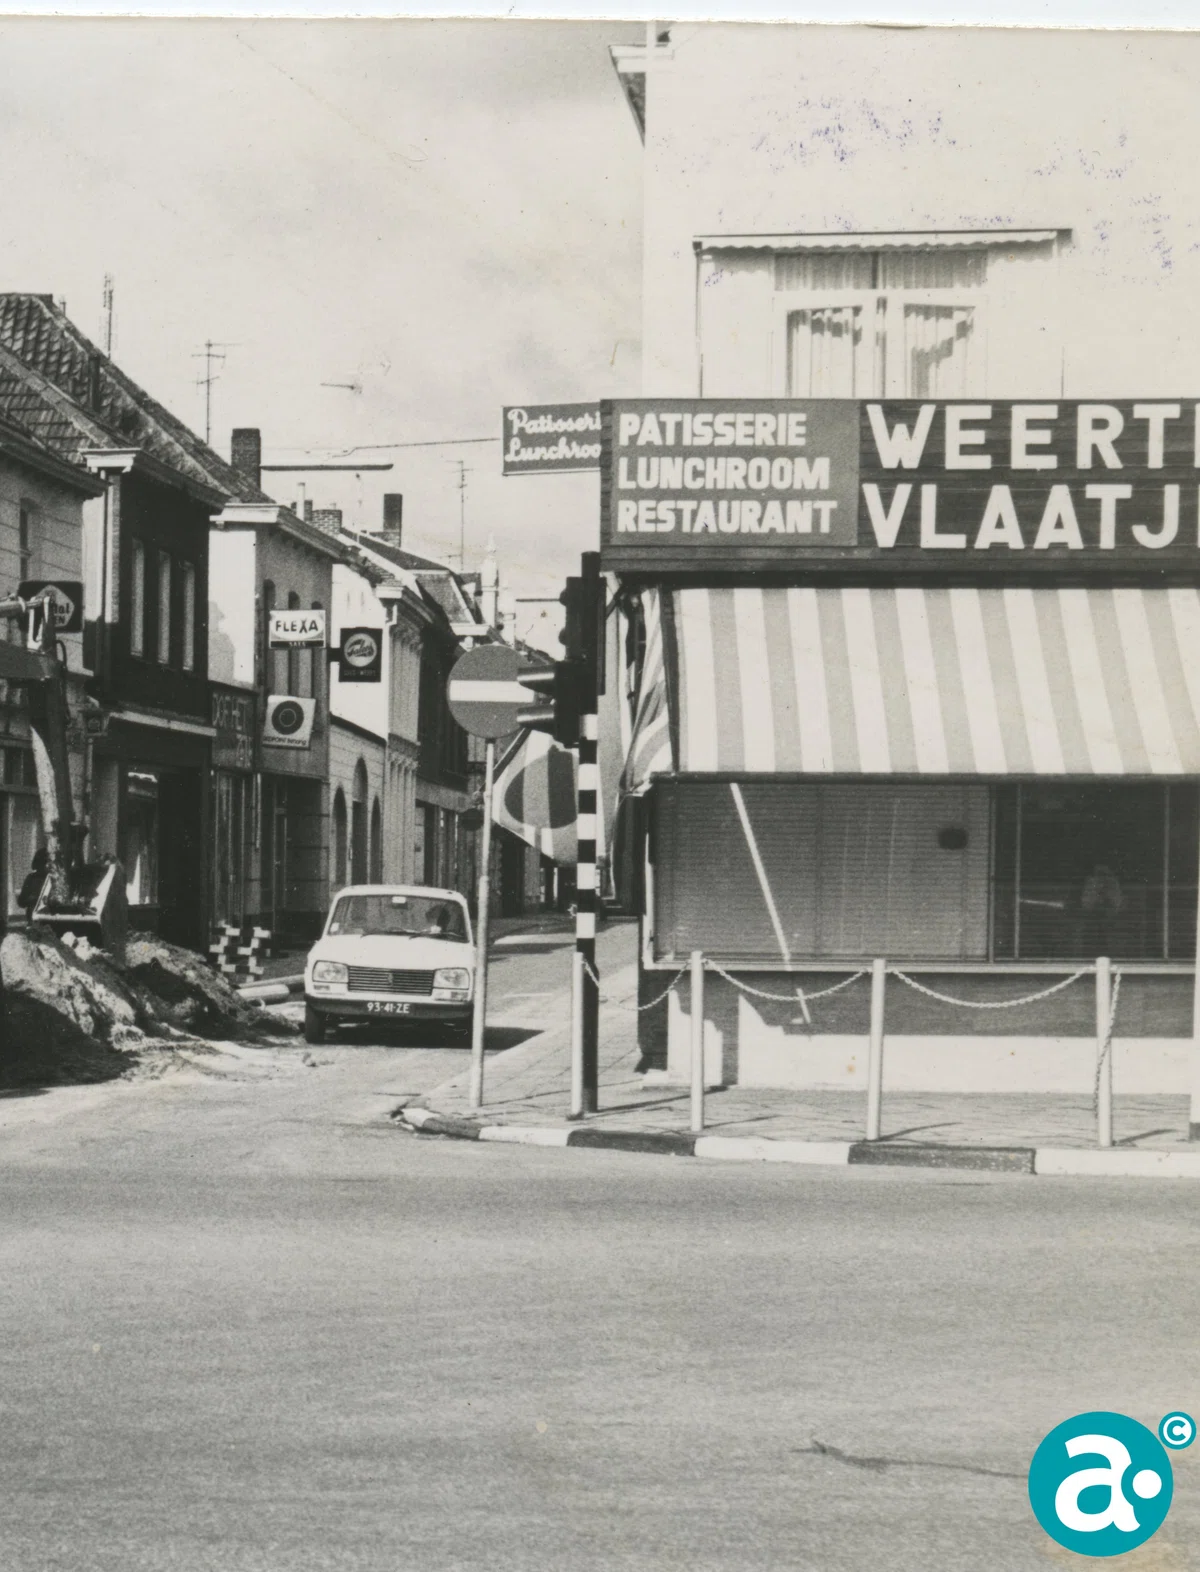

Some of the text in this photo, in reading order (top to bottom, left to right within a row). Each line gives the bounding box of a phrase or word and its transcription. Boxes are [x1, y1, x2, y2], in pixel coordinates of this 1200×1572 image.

[507, 408, 601, 436] Patisseri
[618, 412, 807, 447] PATISSERIE
[865, 403, 1200, 471] WEERT
[504, 436, 601, 463] Lunchroo
[617, 456, 831, 490] LUNCHROOM
[617, 499, 838, 534] RESTAURANT
[861, 483, 1200, 550] VLAATJ
[275, 618, 319, 634] FLEXA
[367, 1001, 410, 1014] 93-41-ZE
